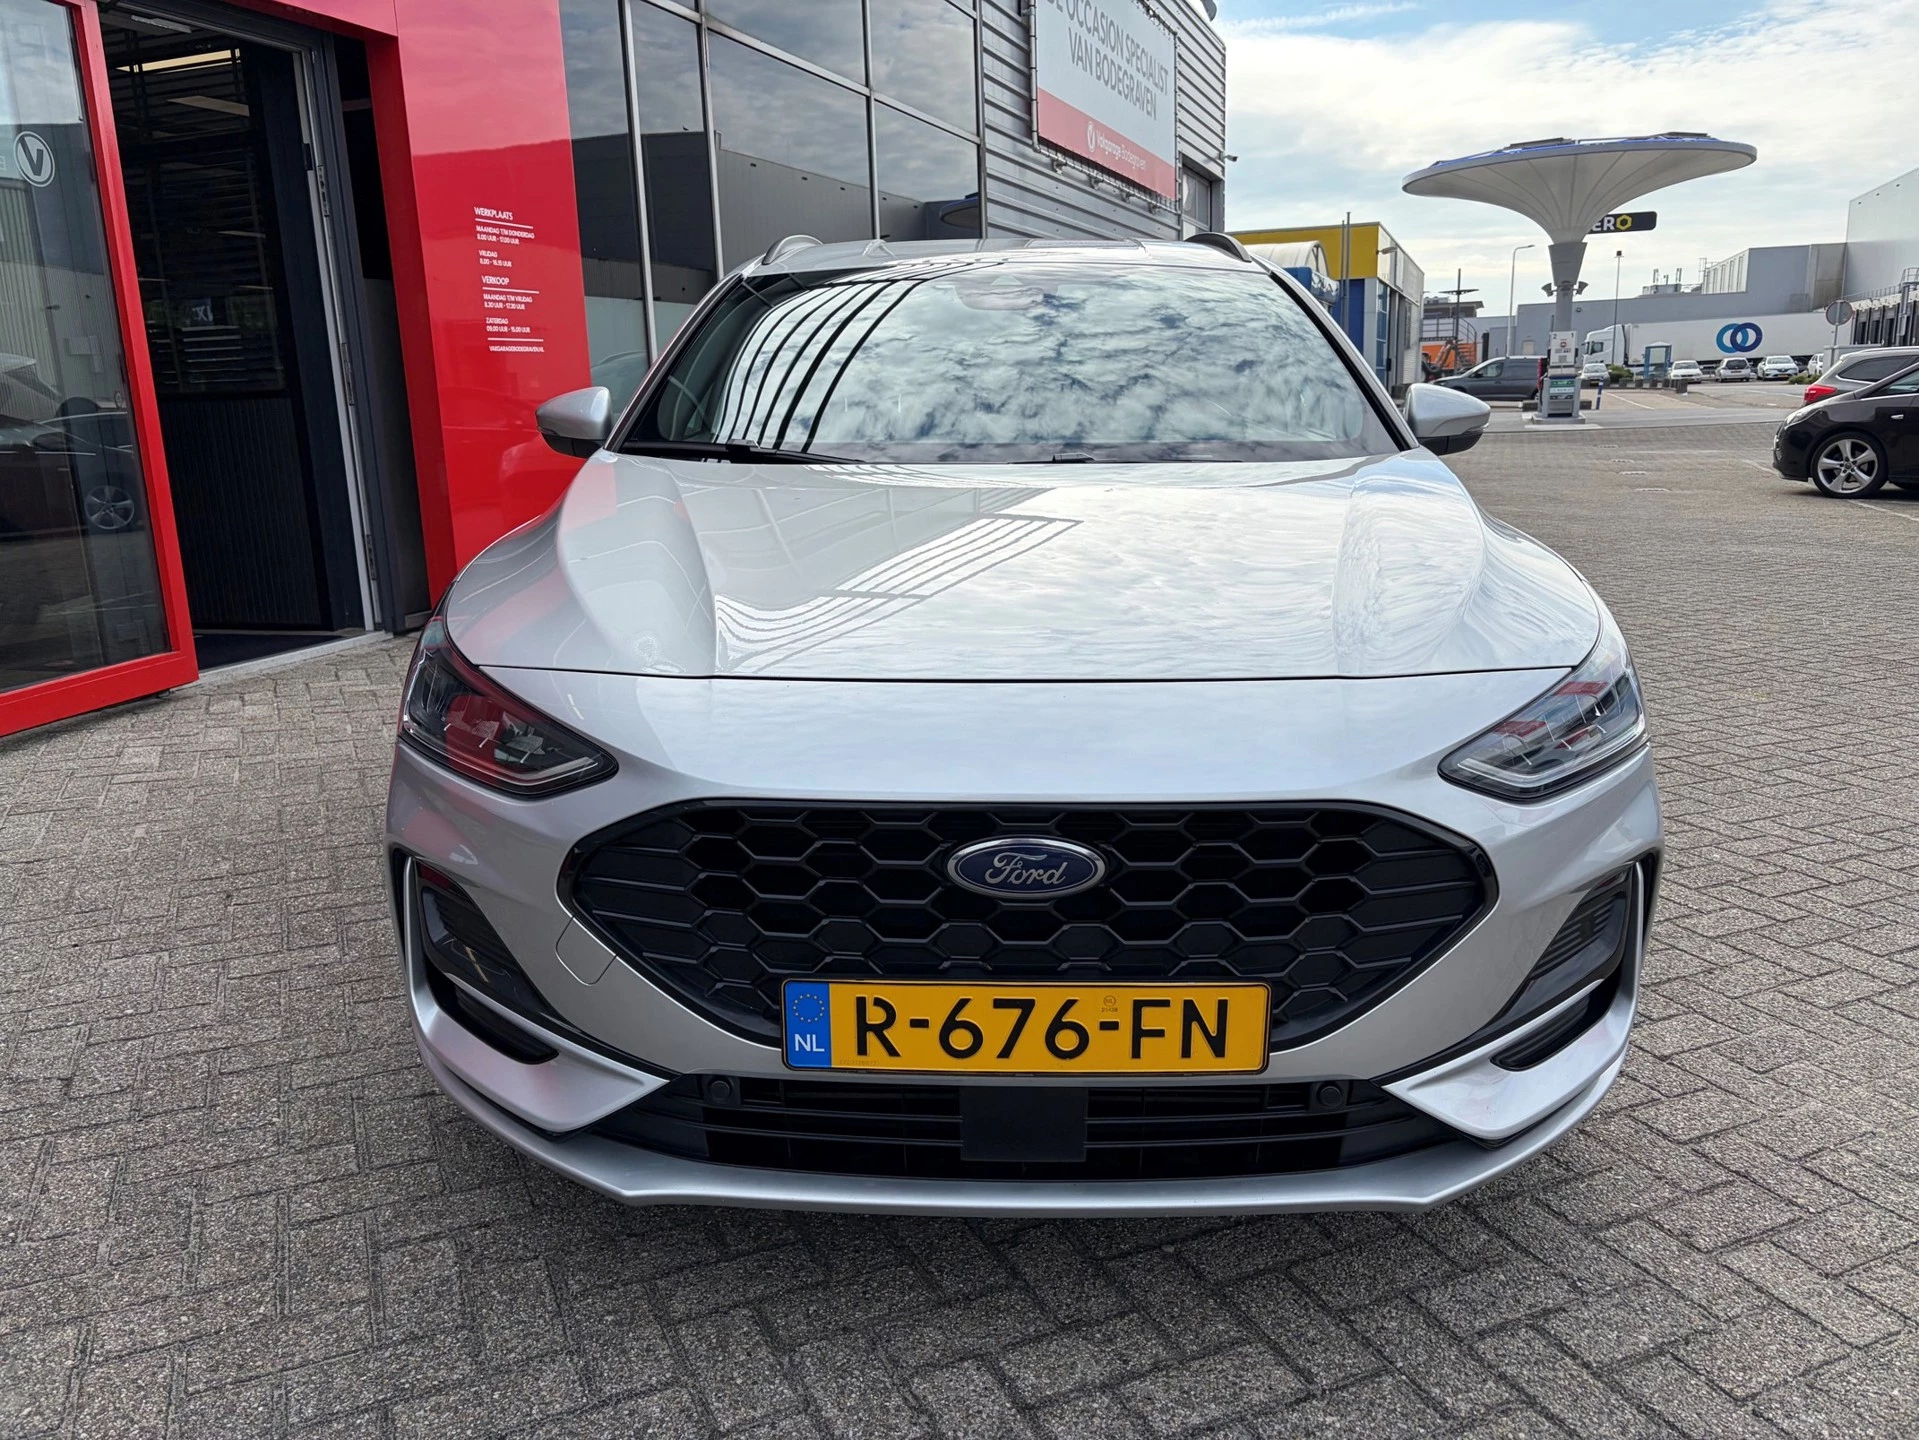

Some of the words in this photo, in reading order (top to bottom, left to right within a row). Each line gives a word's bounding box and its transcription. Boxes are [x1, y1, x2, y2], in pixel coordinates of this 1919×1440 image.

[1066, 0, 1123, 60] OCCASION
[1126, 33, 1168, 96] SPECIALIST
[1068, 27, 1093, 76] VAN
[1096, 47, 1156, 120] BODEGRAVEN
[474, 206, 513, 220] WERKPLAATS
[476, 225, 500, 234] MAANDAG
[509, 229, 535, 239] DONDERDAG
[478, 249, 498, 258] VRIJDAG
[481, 275, 509, 285] VERKOOP
[483, 293, 506, 301] MAANDAG
[984, 851, 1069, 885] Ford
[855, 995, 1229, 1060] R-676-FN
[794, 1033, 825, 1053] NL
